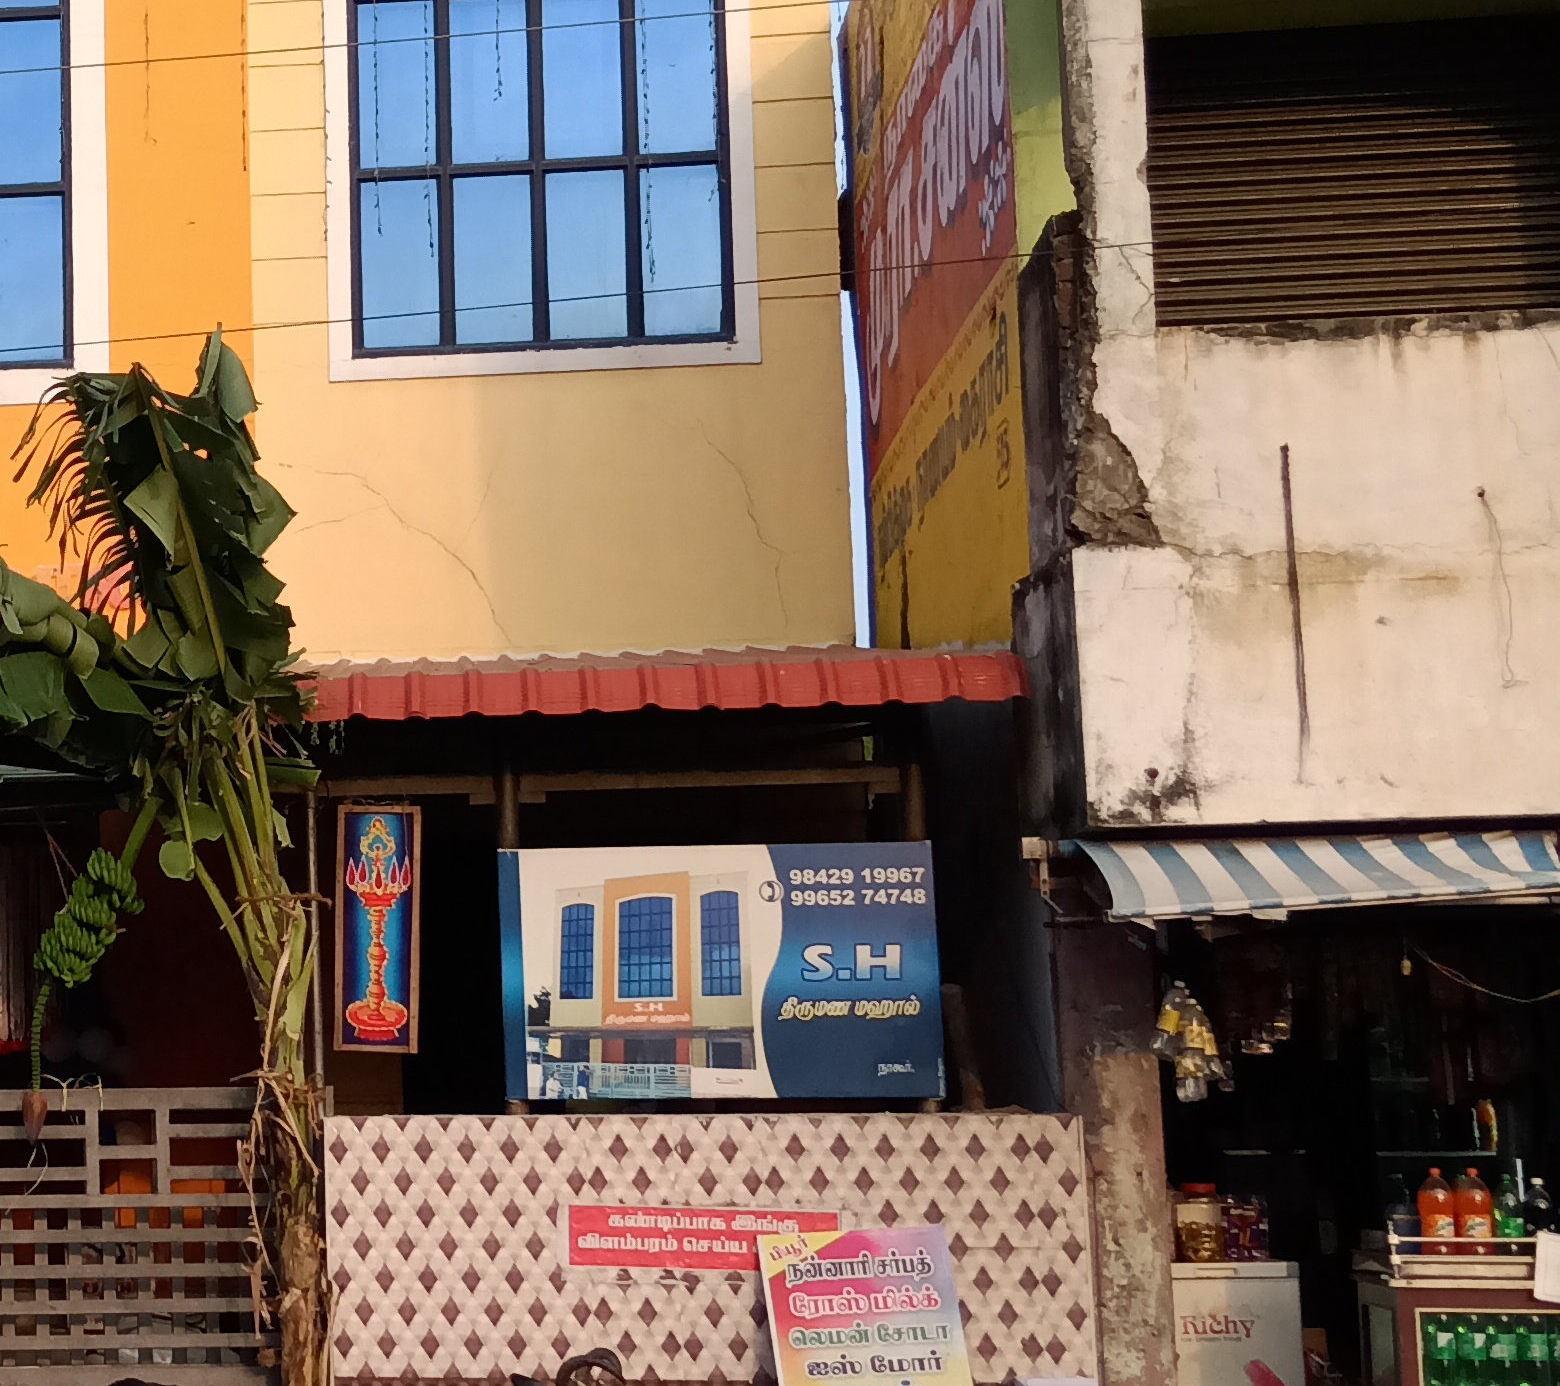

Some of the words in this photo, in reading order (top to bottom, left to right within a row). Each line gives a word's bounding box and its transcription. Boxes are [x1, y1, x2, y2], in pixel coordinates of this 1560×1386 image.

[789, 868, 854, 885] 98429
[860, 866, 926, 884] 19967
[790, 889, 855, 906] 99652
[861, 888, 926, 905] 74748
[801, 943, 903, 982] S.H
[777, 996, 851, 1021] திருமண
[607, 1211, 727, 1233] கண்டிப்பாக
[731, 1214, 800, 1234] இங்கு
[577, 1233, 678, 1254] விளம்பரம்
[682, 1236, 748, 1254] செய்ய
[787, 1252, 871, 1284] நன்னாரி
[875, 1249, 932, 1280] சர்பத்
[791, 1289, 867, 1315] ரோஸ்
[872, 1285, 941, 1311] மில்க்
[791, 1322, 870, 1346] லெமன்
[876, 1323, 949, 1343] சோடா
[1180, 1312, 1255, 1338] Richy
[806, 1353, 863, 1376] ஐஸ்
[870, 1349, 943, 1373] மோர்
